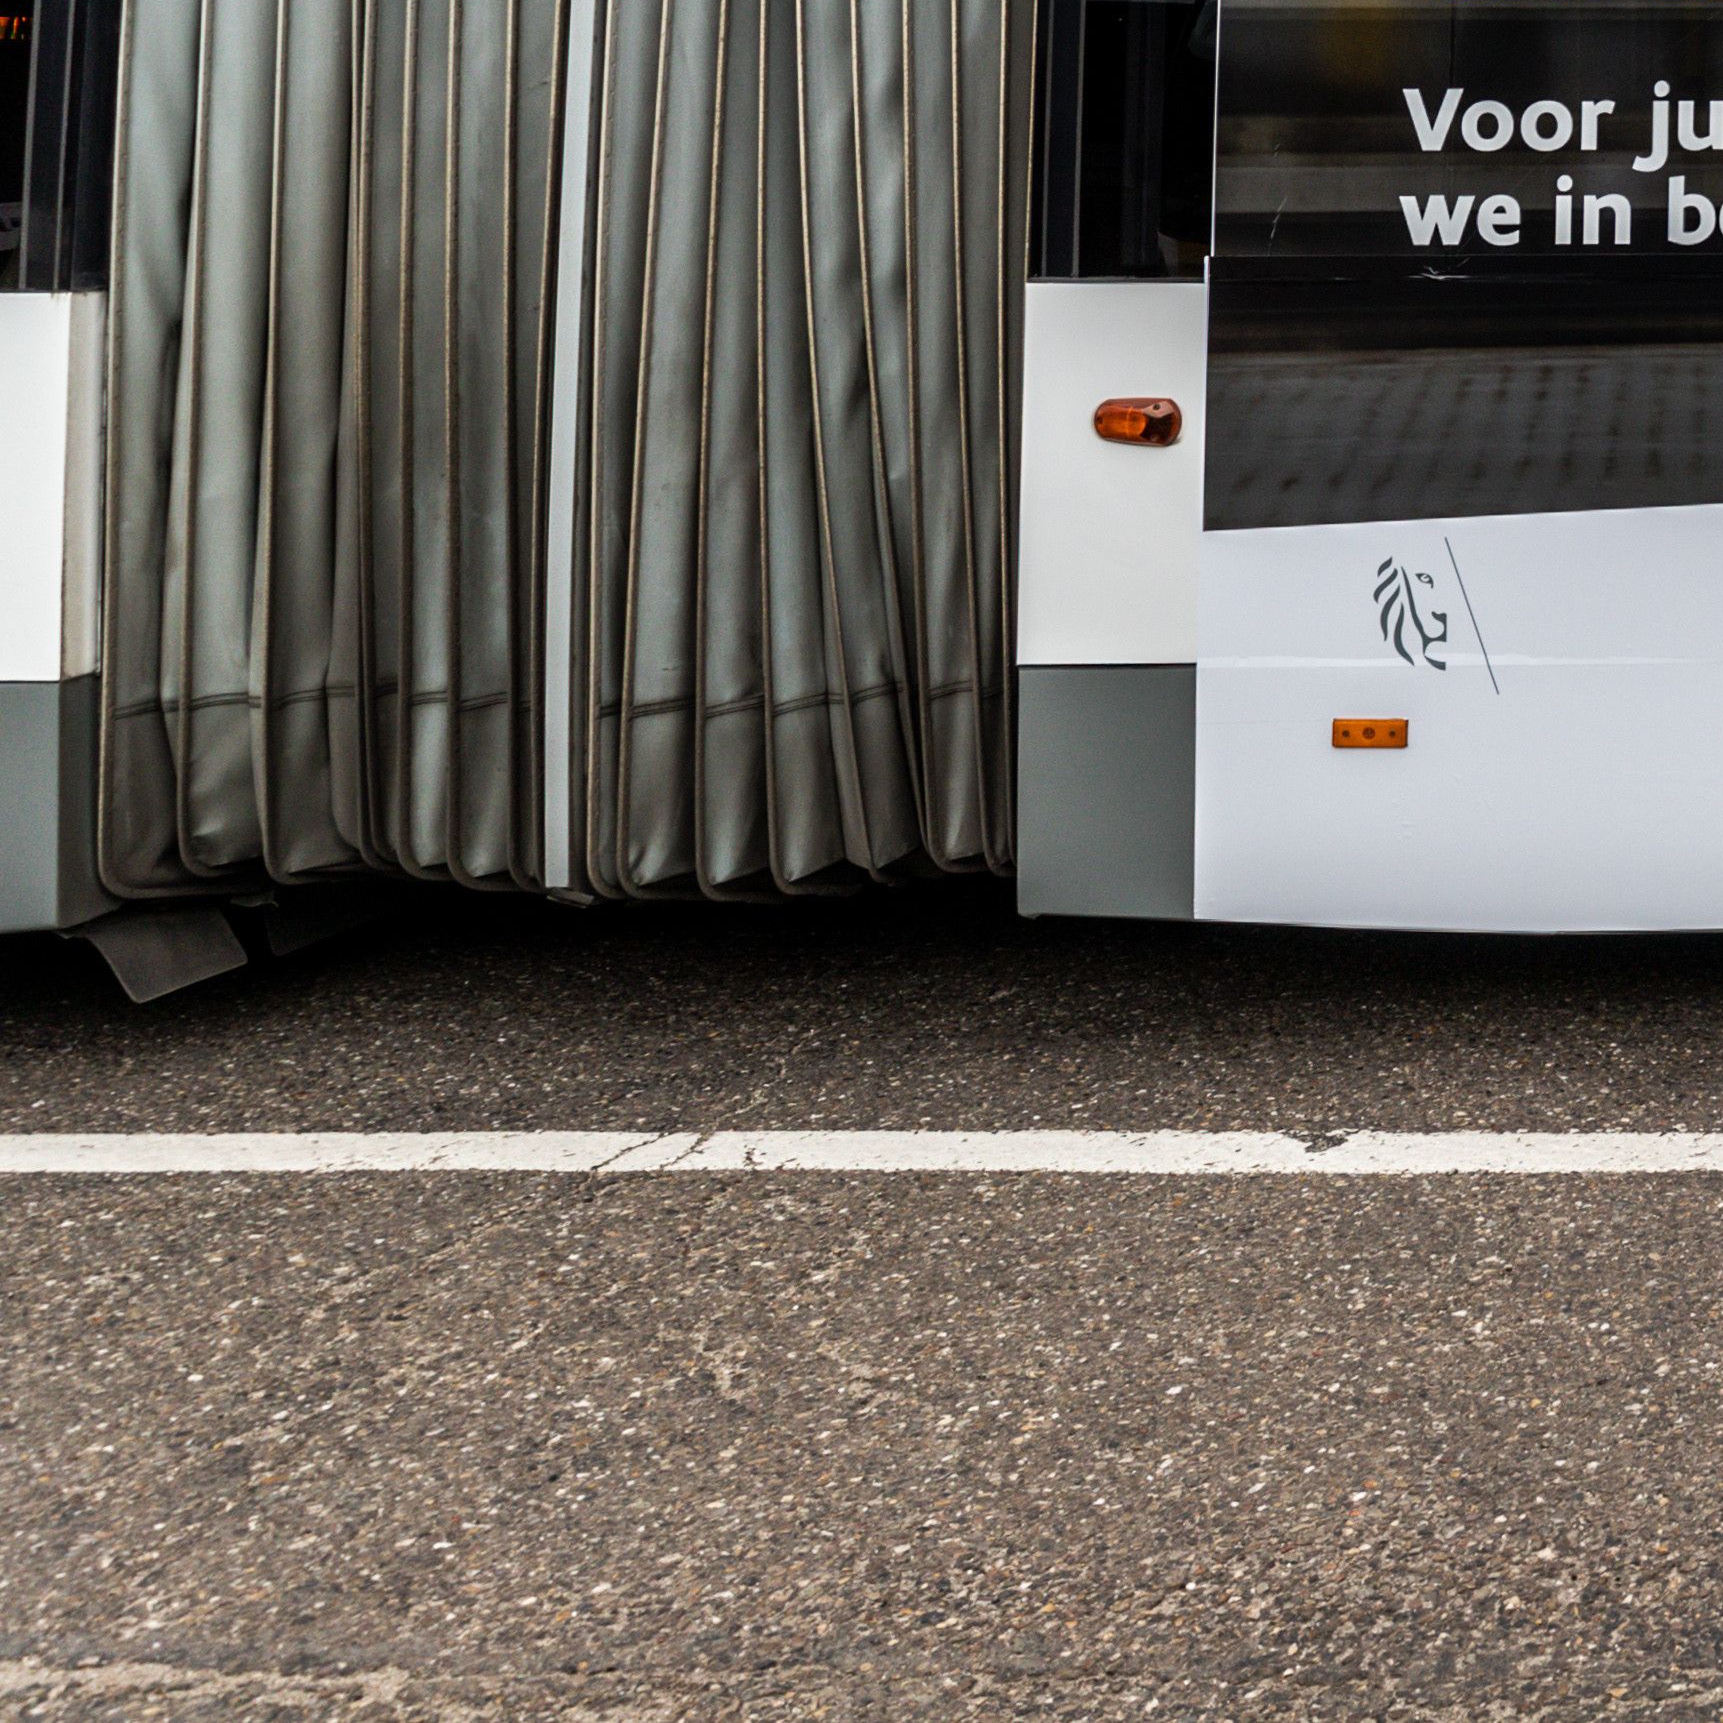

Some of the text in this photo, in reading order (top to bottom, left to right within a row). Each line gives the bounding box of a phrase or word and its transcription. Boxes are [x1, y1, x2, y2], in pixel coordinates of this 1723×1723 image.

[1402, 88, 1616, 152] Voor
[1398, 194, 1522, 246] we
[1555, 174, 1633, 246] in
